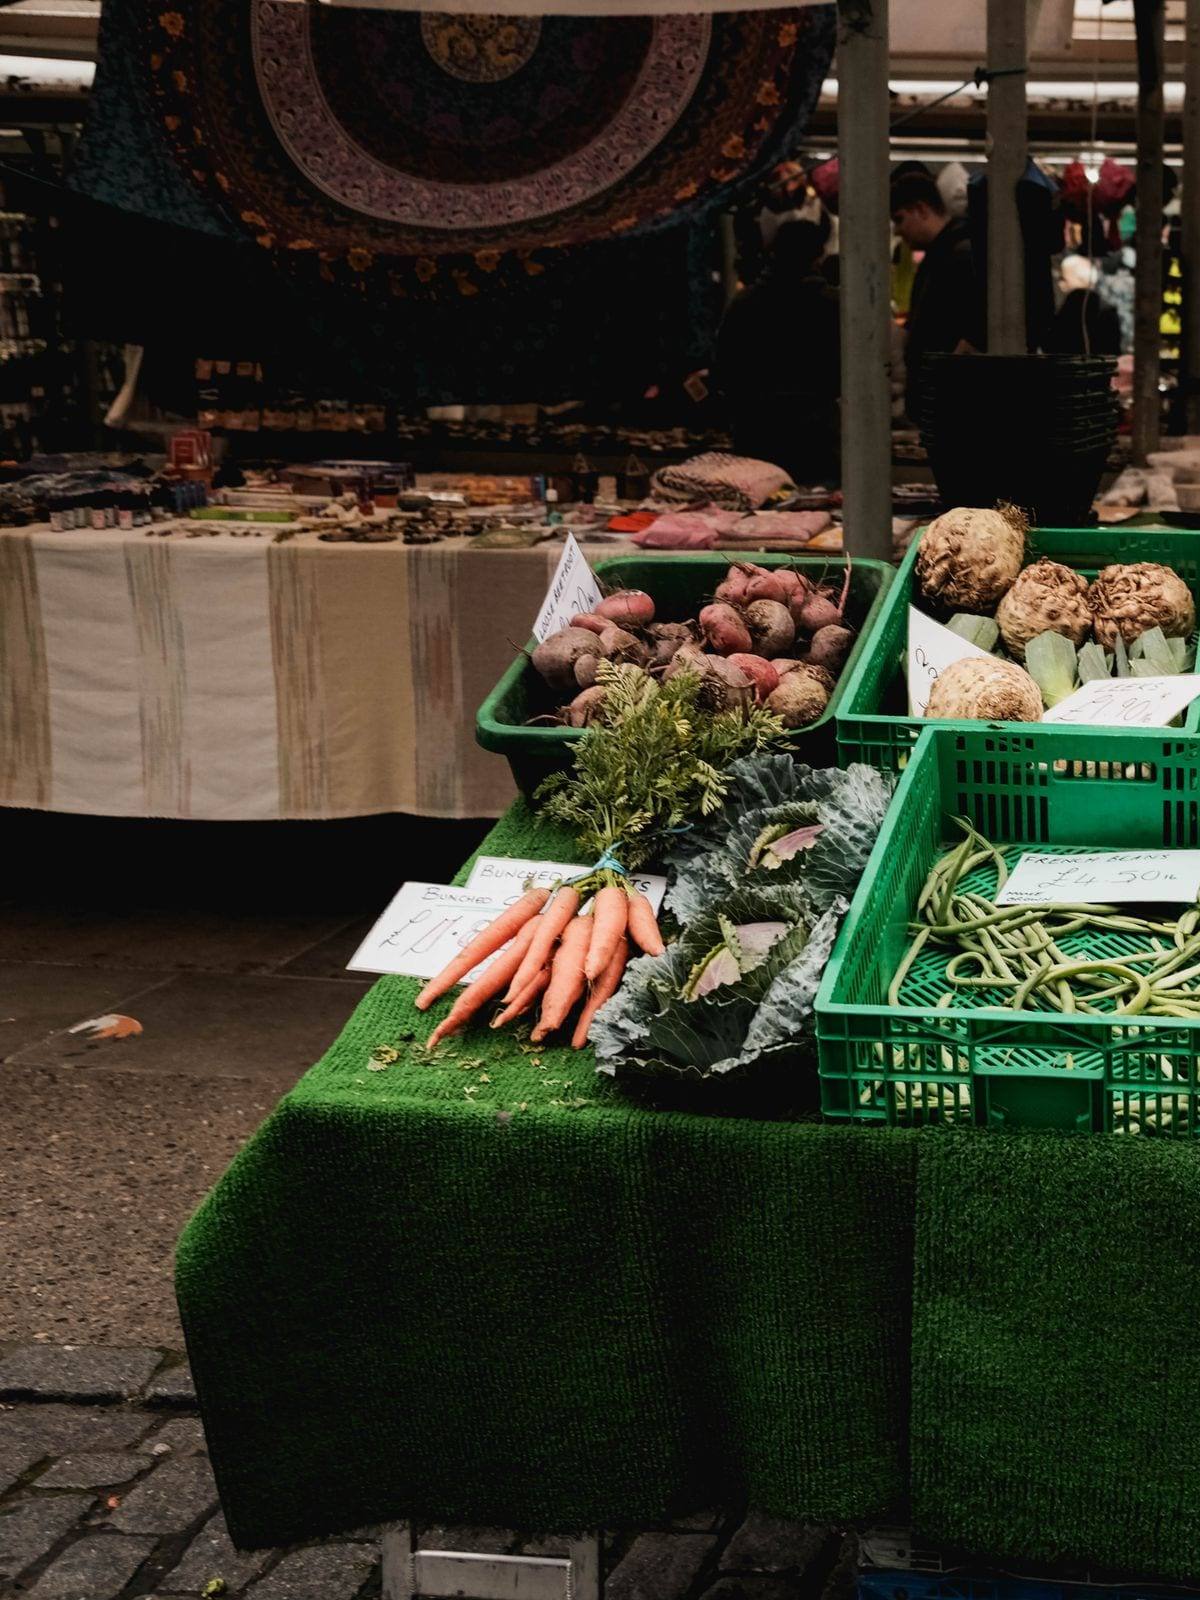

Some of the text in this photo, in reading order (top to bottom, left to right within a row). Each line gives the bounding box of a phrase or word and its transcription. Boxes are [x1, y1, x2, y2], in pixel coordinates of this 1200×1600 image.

[1024, 853, 1169, 865] FRENCH BEANS
[480, 864, 562, 882] BUNCHED
[421, 886, 493, 904] BUNCHED
